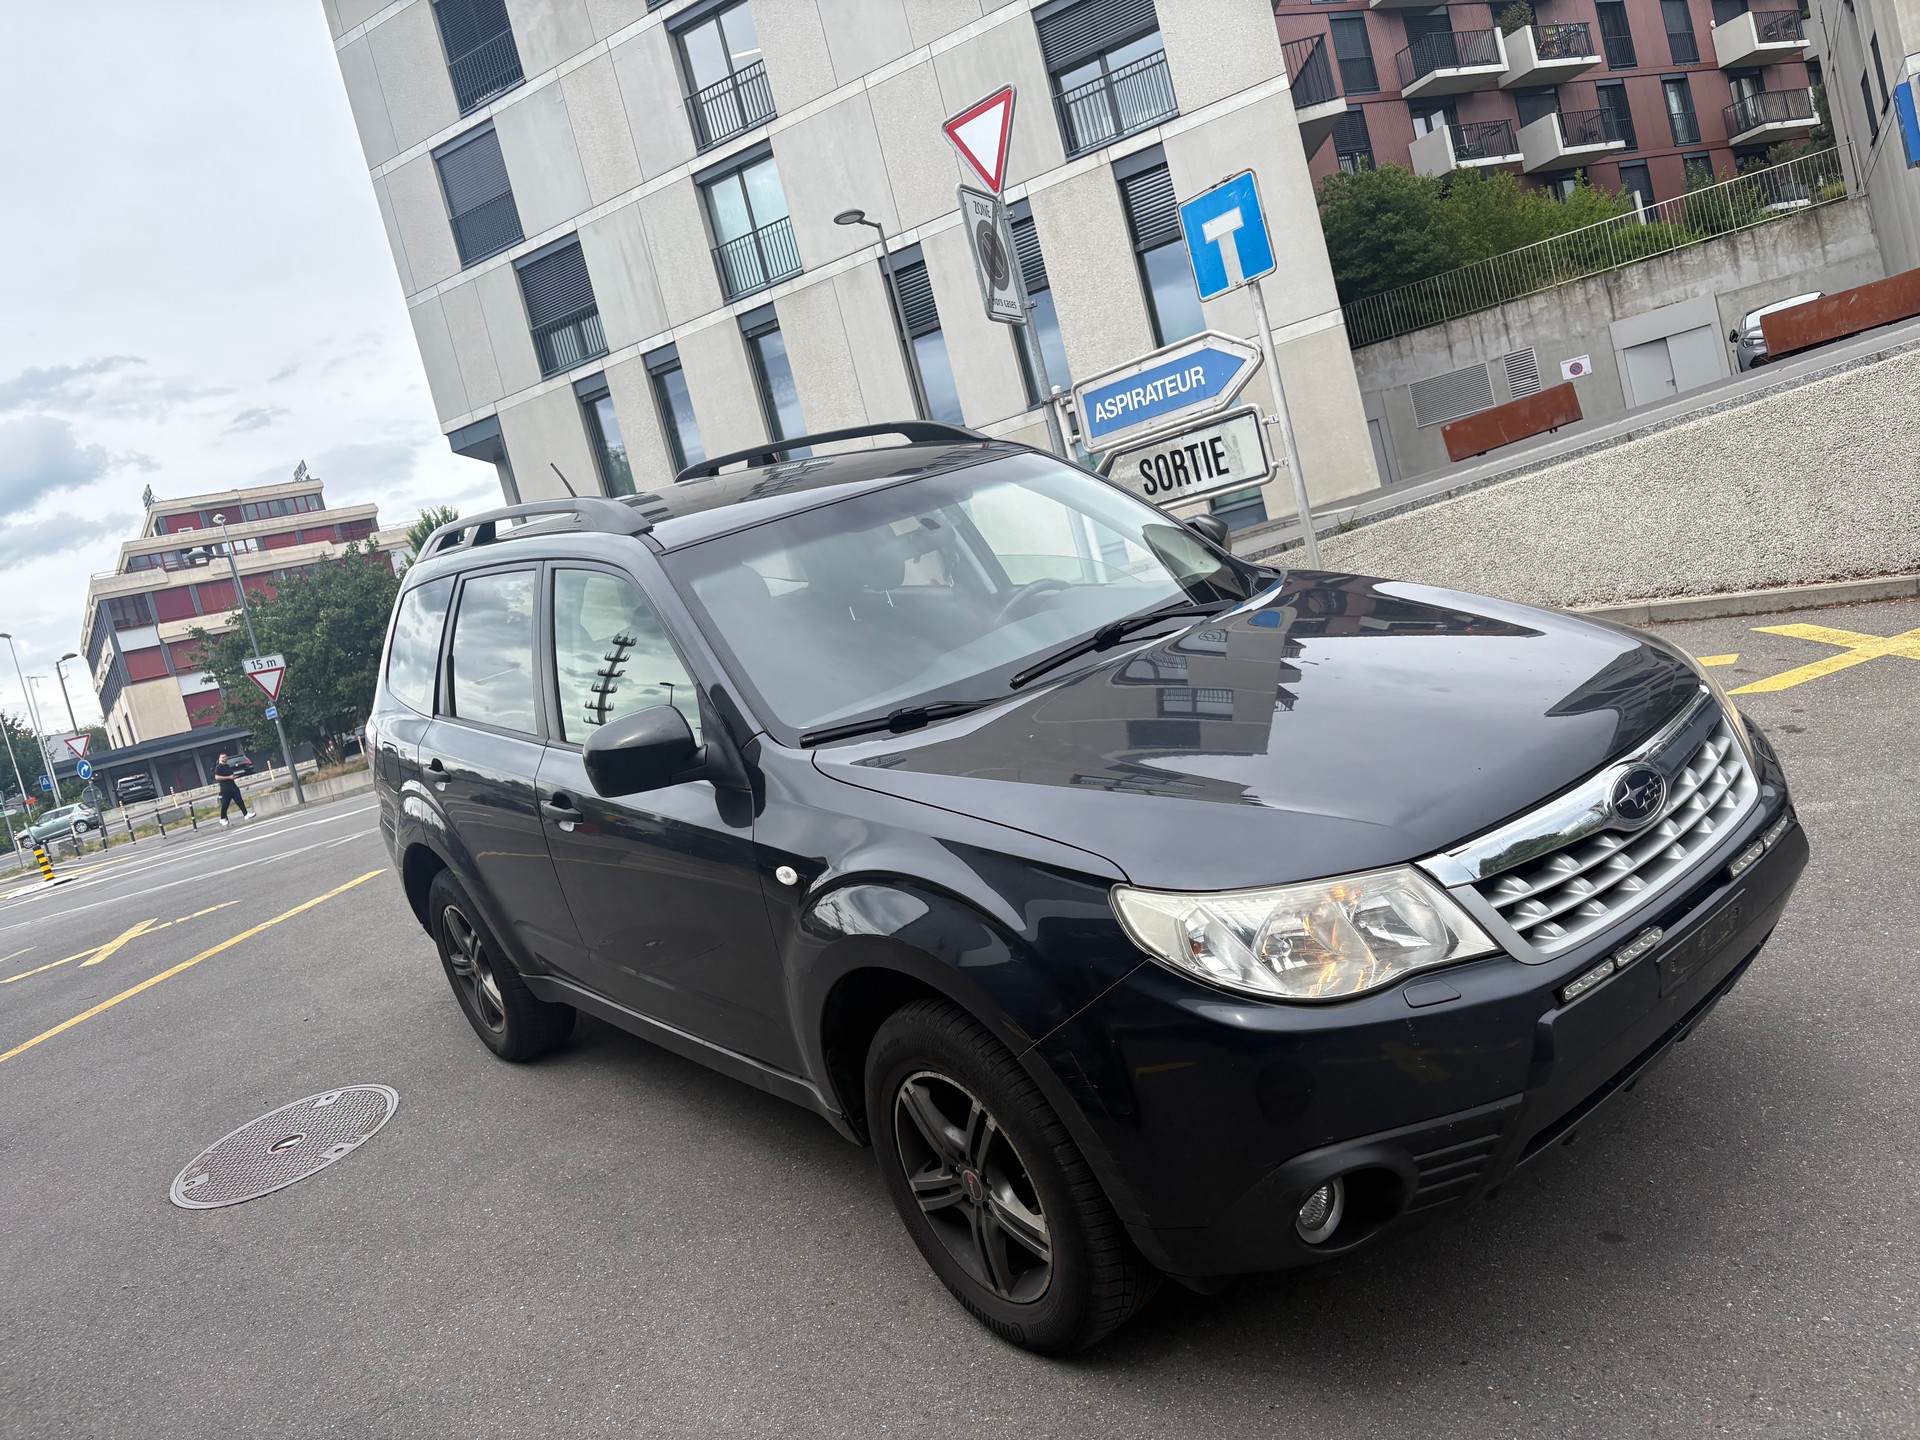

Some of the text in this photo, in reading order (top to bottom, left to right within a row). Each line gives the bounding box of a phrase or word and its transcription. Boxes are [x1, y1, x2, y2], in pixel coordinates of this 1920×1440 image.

[973, 200, 991, 218] ZONE
[1095, 366, 1206, 424] ASPIRATEUR
[1139, 436, 1230, 496] SORTIE
[251, 659, 277, 670] 15 m
